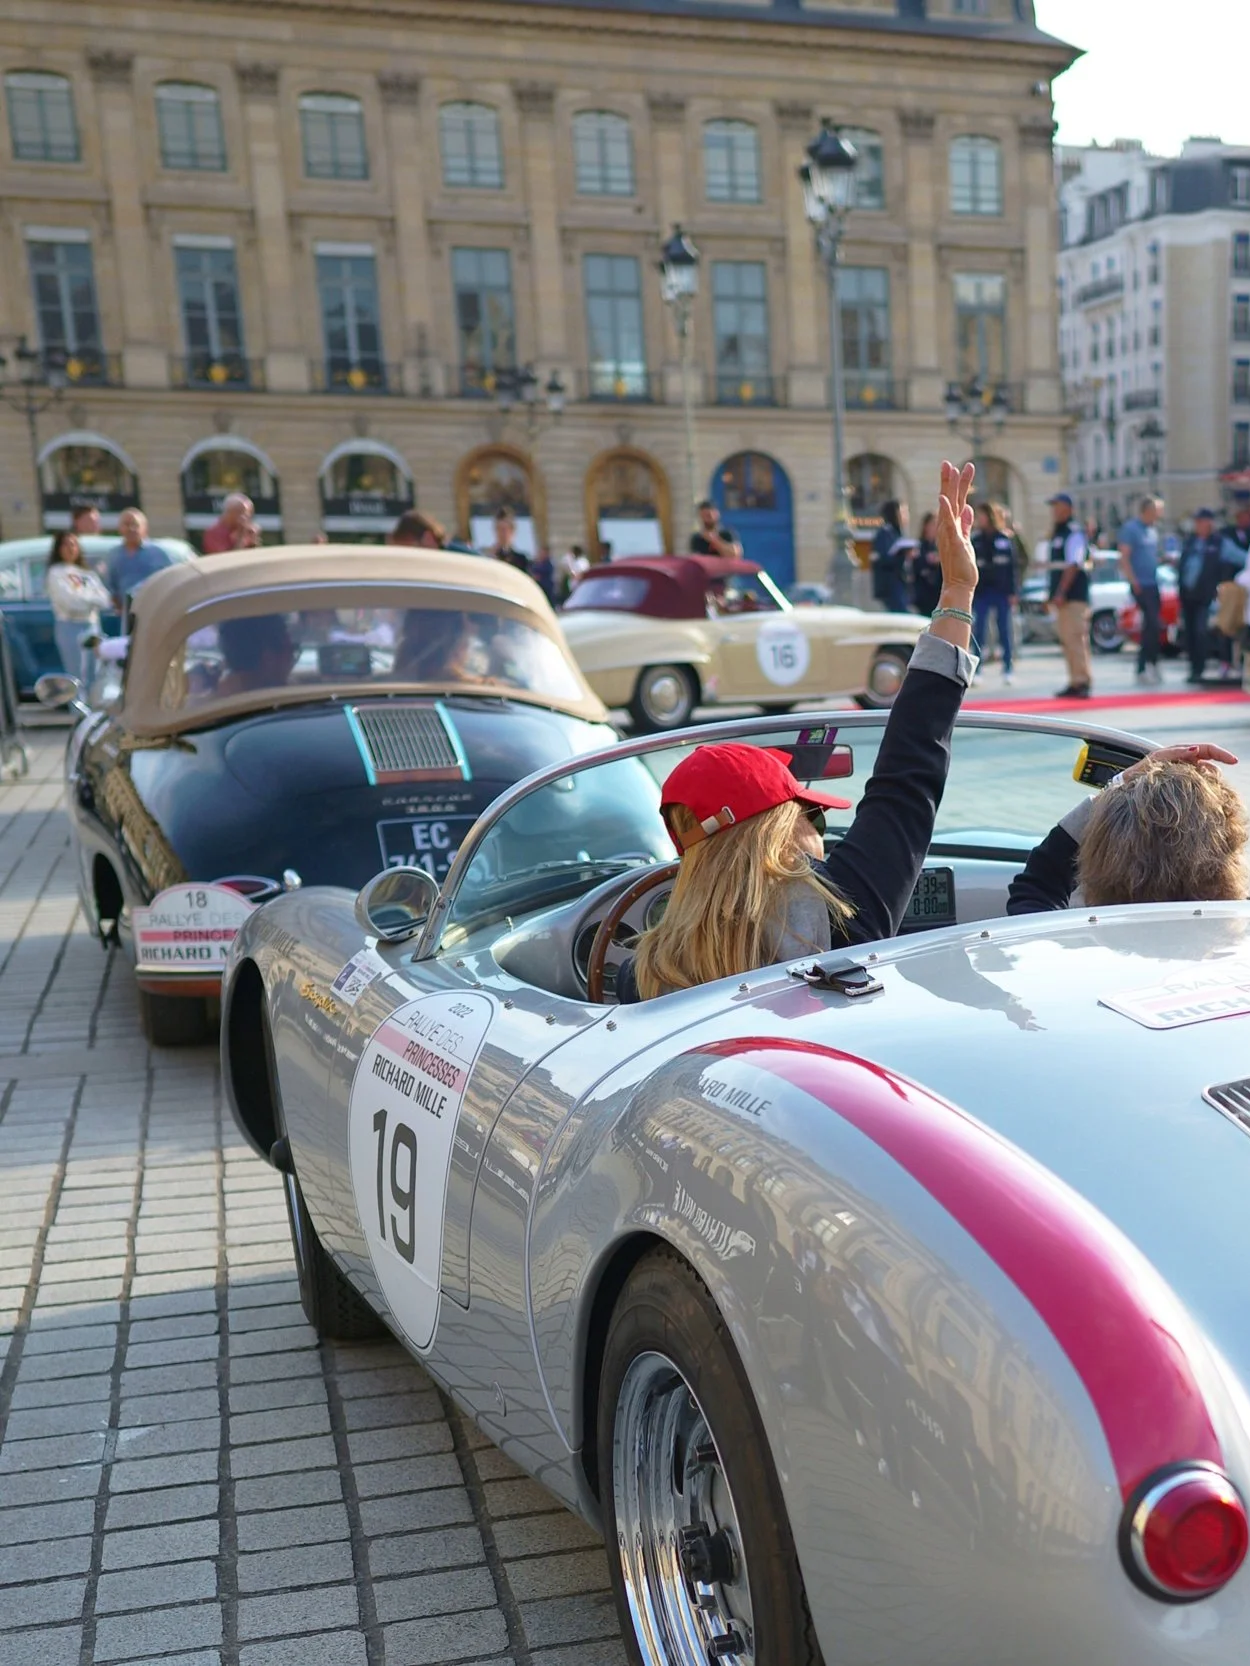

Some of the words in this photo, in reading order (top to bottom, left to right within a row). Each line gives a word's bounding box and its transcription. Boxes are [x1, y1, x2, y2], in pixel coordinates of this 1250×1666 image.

[770, 643, 797, 670] 16
[411, 821, 451, 850] EC
[185, 890, 208, 909] 18
[149, 911, 201, 927] RALLYE
[209, 911, 244, 926] DES
[141, 946, 212, 961] RICHARD
[447, 1002, 474, 1019] 2022
[404, 1010, 445, 1042] RALLYE
[435, 1028, 464, 1054] DES
[402, 1040, 461, 1089] PRINCESSES
[372, 1053, 416, 1098] RICHARD
[413, 1080, 448, 1119] MILLE
[722, 1087, 773, 1117] MILLE
[373, 1108, 418, 1265] 19
